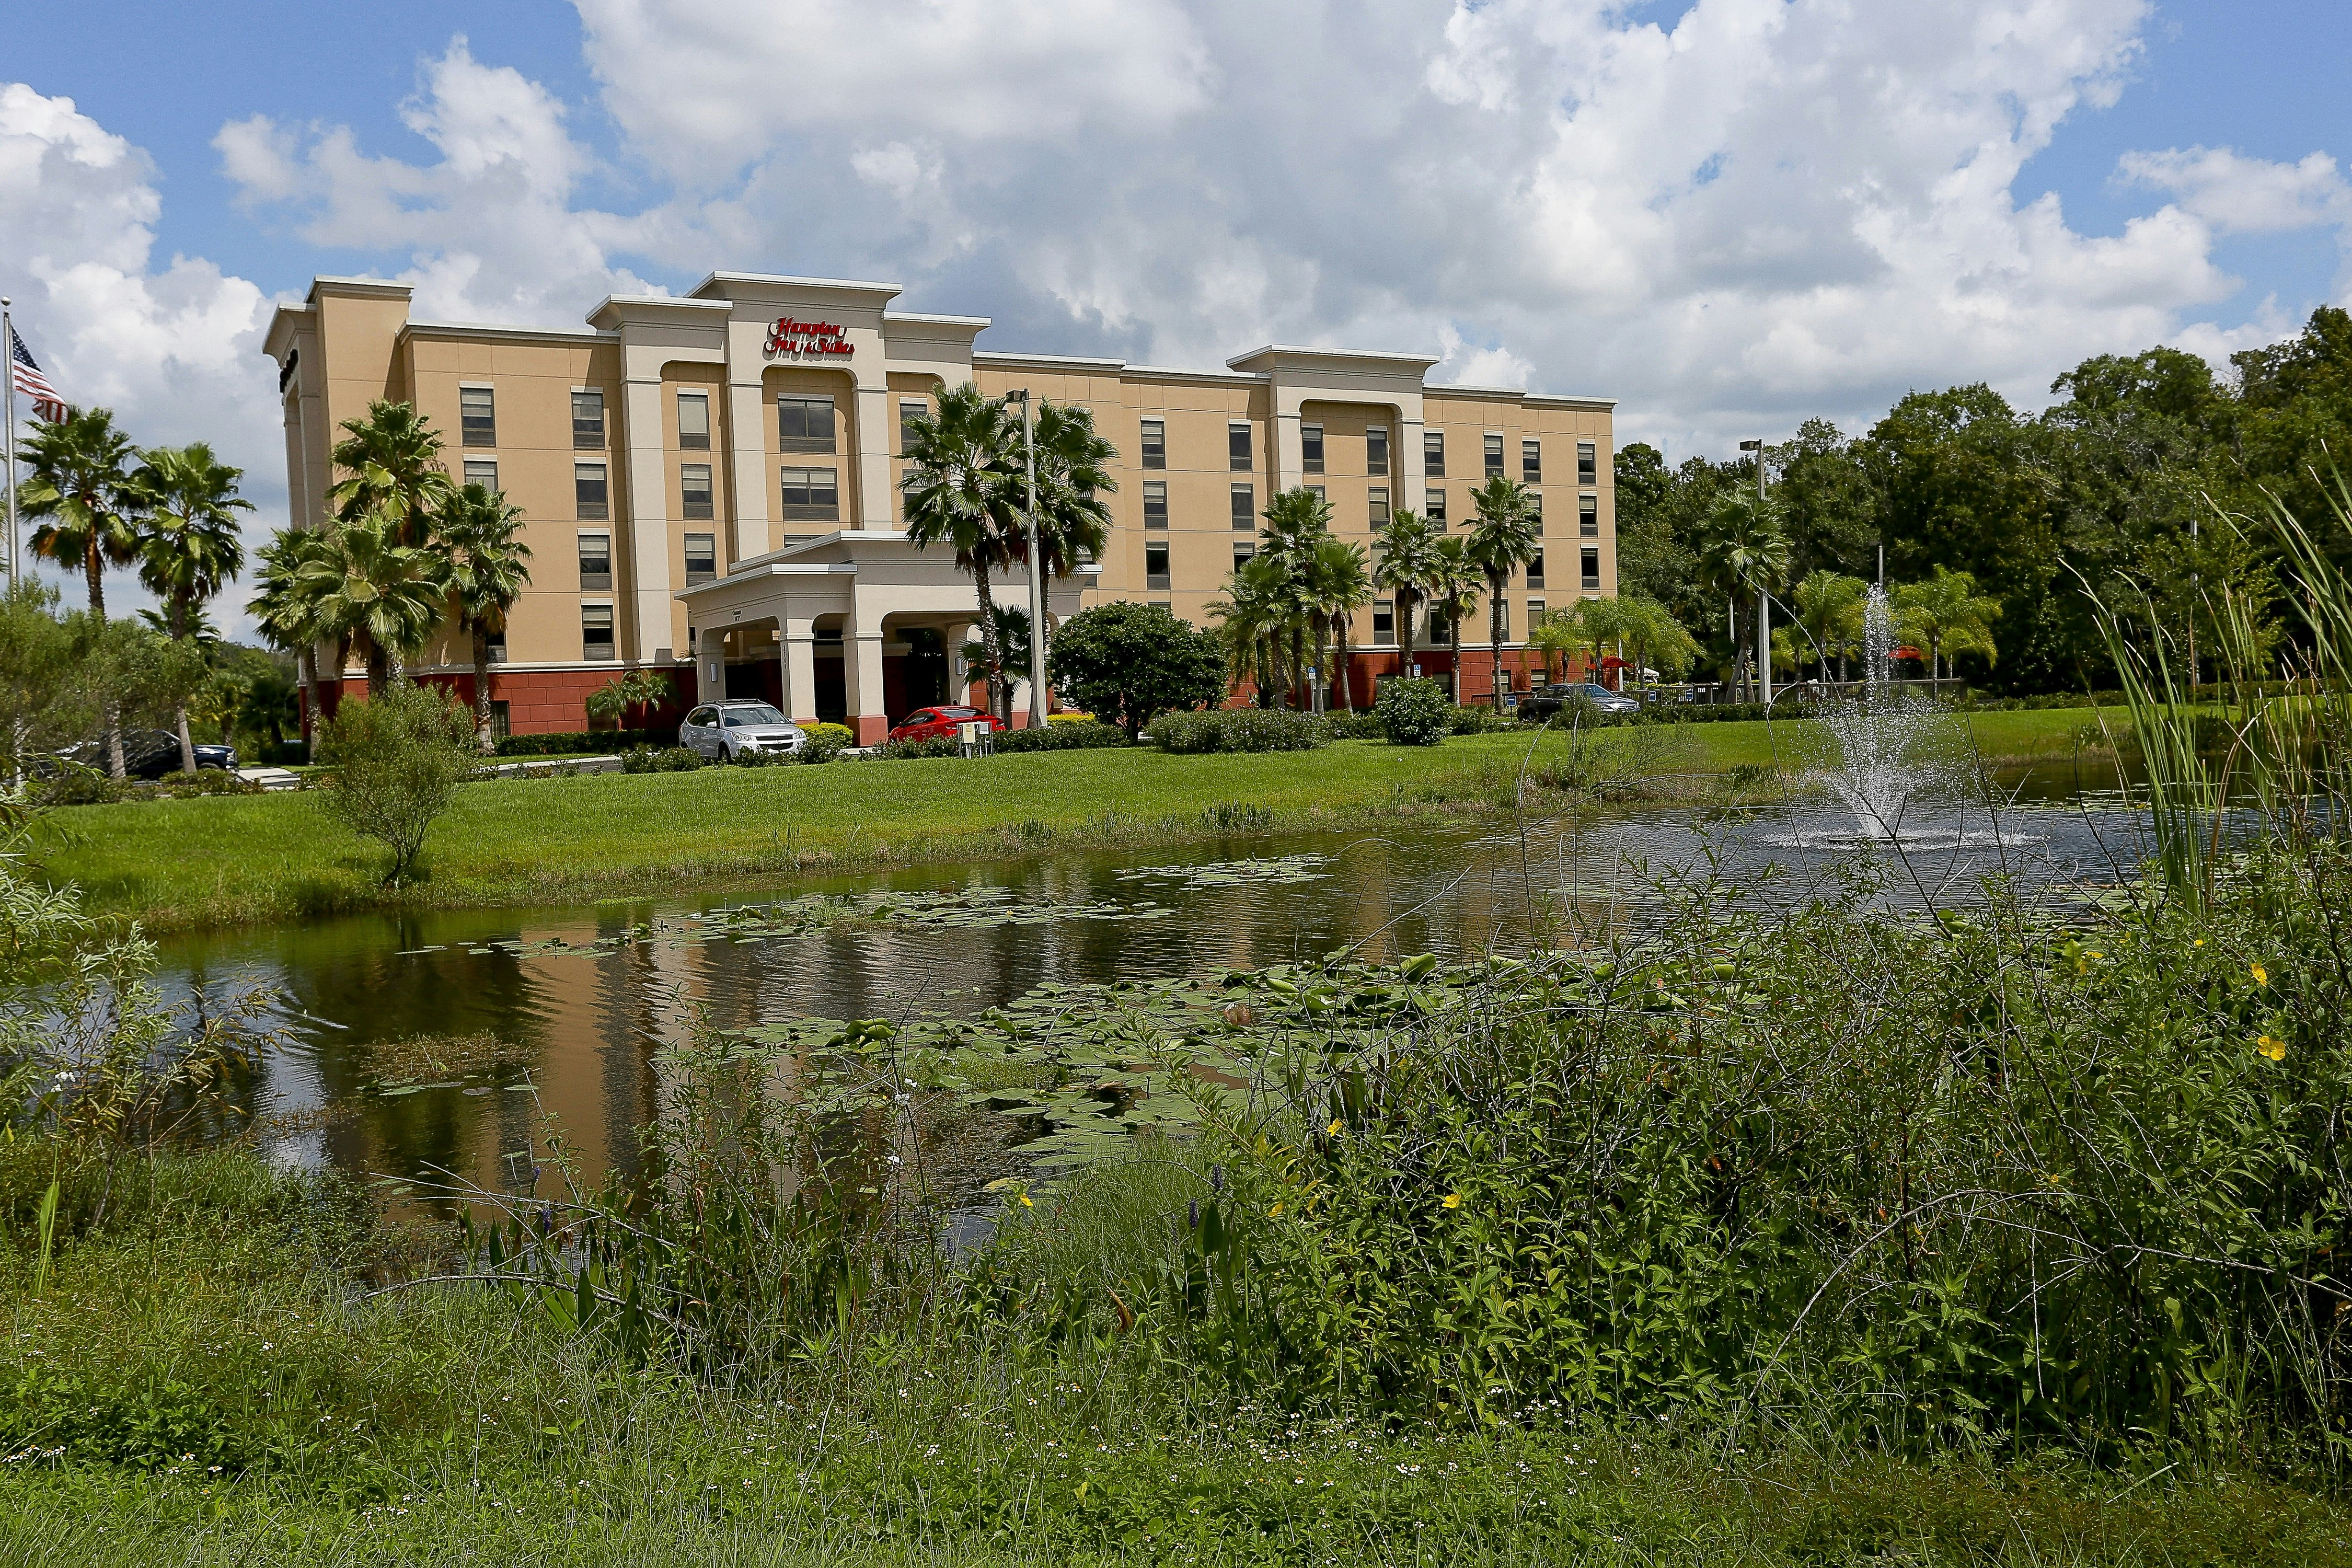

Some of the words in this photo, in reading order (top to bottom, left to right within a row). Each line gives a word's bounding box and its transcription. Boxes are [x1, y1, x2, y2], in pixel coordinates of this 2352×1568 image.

[768, 316, 847, 338] Hampton
[764, 337, 803, 354] Inn
[804, 342, 814, 354] &
[813, 337, 855, 354] Suites
